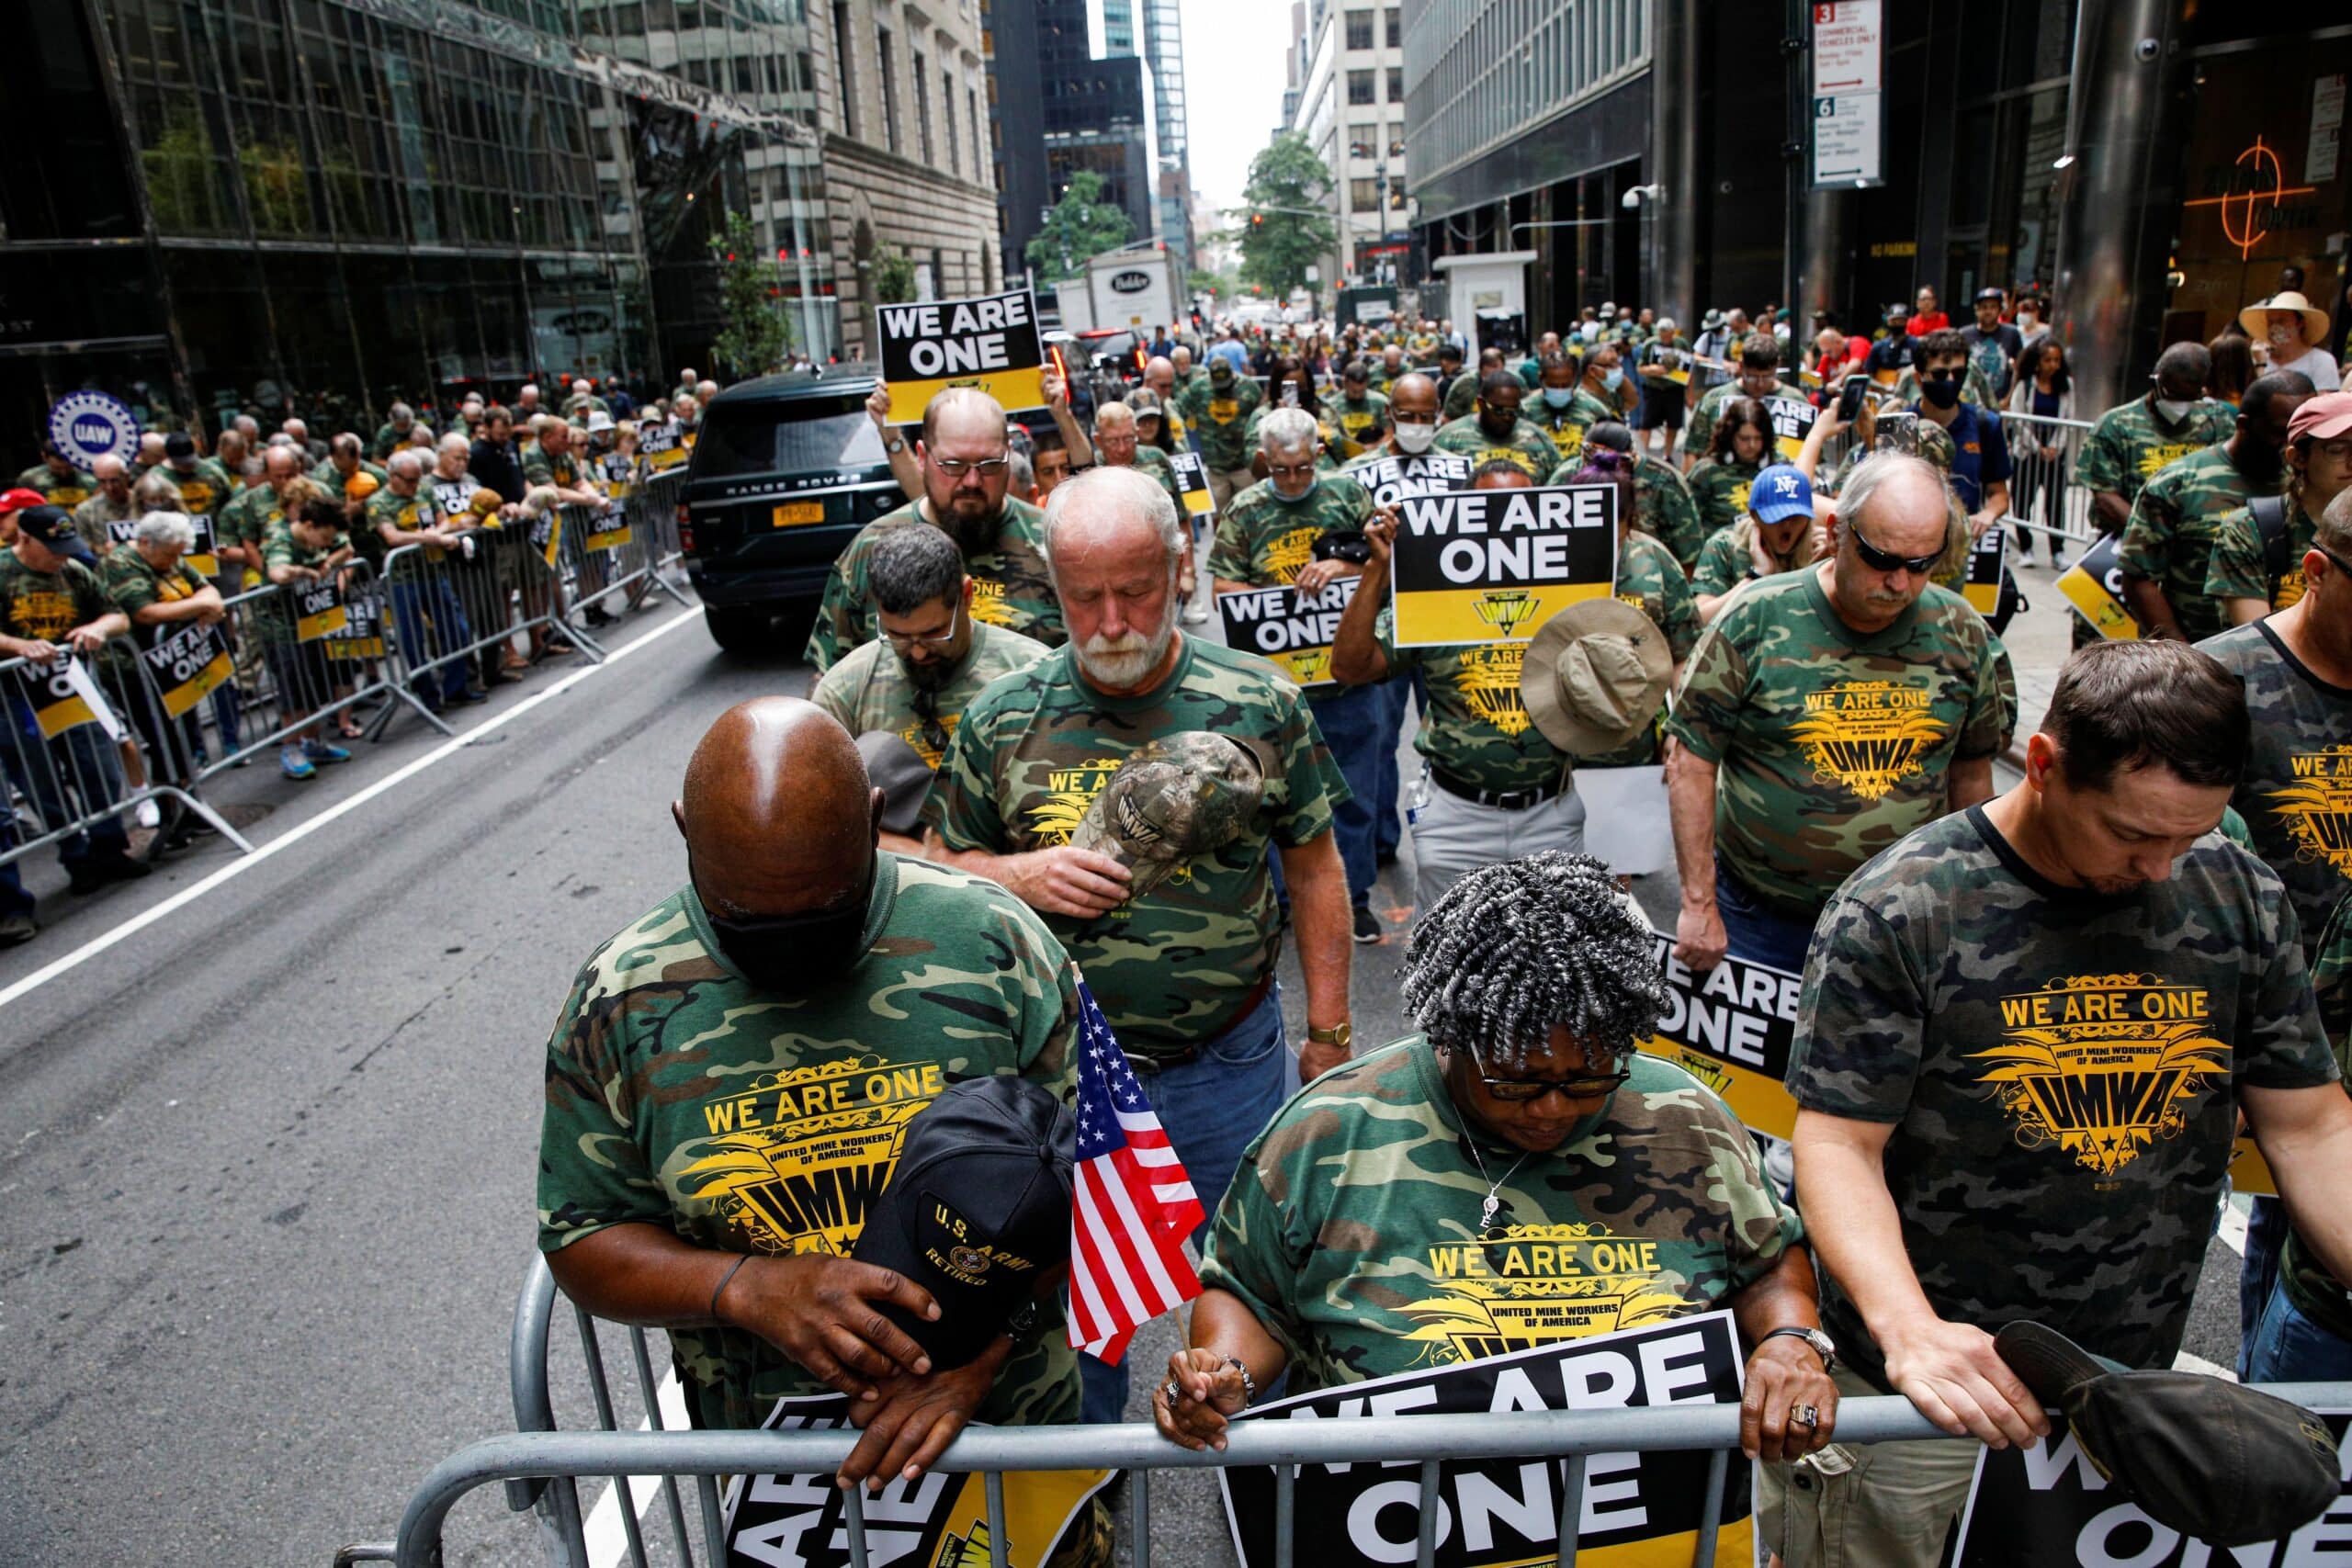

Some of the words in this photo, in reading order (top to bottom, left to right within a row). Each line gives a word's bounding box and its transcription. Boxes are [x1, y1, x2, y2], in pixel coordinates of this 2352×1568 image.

[1820, 5, 1831, 24] 3
[1819, 99, 1831, 118] 6
[884, 307, 942, 339] WE
[950, 294, 1029, 333] ARE
[910, 333, 1009, 376] ONE
[1769, 399, 1814, 423] ARE
[74, 423, 113, 444] UAW
[1173, 457, 1198, 472] RE
[1348, 459, 1398, 488] WE
[1406, 458, 1467, 479] ARE
[727, 481, 786, 495] RANGE
[797, 473, 861, 488] ROVER
[1374, 478, 1449, 510] ONE
[1774, 476, 1799, 498] NY
[446, 496, 471, 514] ON
[1402, 496, 1488, 536] WE
[1499, 491, 1604, 531] ARE
[1440, 535, 1569, 583] ONE
[305, 589, 334, 614] ONE
[1225, 592, 1286, 623] WE
[1255, 612, 1342, 651] ONE
[150, 637, 187, 669] WE
[174, 639, 215, 681] ONE
[1460, 650, 1484, 666] WE
[1490, 649, 1523, 664] ARE
[1804, 694, 1836, 711] WE
[1841, 692, 1883, 709] ARE
[1889, 690, 1931, 708] ONE
[1820, 738, 1916, 773] UMWA
[2291, 757, 2328, 776] WE
[1048, 772, 1084, 793] WE
[1702, 961, 1804, 1023] ARE
[2001, 998, 2053, 1027] WE
[2064, 993, 2130, 1022] ARE
[2142, 991, 2209, 1020] ONE
[1657, 987, 1769, 1067] ONE
[2056, 1048, 2083, 1059] UNITED
[2086, 1047, 2110, 1055] MINE
[2112, 1045, 2162, 1055] WORKERS
[2076, 1056, 2087, 1065] OF
[2091, 1055, 2134, 1065] AMERICA
[705, 1098, 762, 1134] WE
[775, 1080, 854, 1122] ARE
[865, 1065, 944, 1103] ONE
[2025, 1069, 2186, 1129] UMWA
[770, 1147, 807, 1163] UNITED
[809, 1139, 838, 1156] MINE
[840, 1132, 894, 1149] WORKERS
[800, 1155, 815, 1166] OF
[817, 1146, 865, 1162] AMERICA
[744, 1161, 897, 1235] UMW
[935, 1203, 967, 1244] U.S.
[977, 1245, 1035, 1271] ARMY
[926, 1247, 988, 1286] RETIRED
[1429, 1247, 1487, 1278] WE
[1502, 1245, 1581, 1276] ARE
[1591, 1243, 1661, 1273] ONE
[1492, 1307, 1532, 1317] UNITED
[1535, 1306, 1564, 1316] MINE
[1566, 1303, 1619, 1314] WORKERS
[1525, 1318, 1540, 1327] OF
[1543, 1316, 1591, 1326] AMERICA
[1347, 1451, 1648, 1563] ONE
